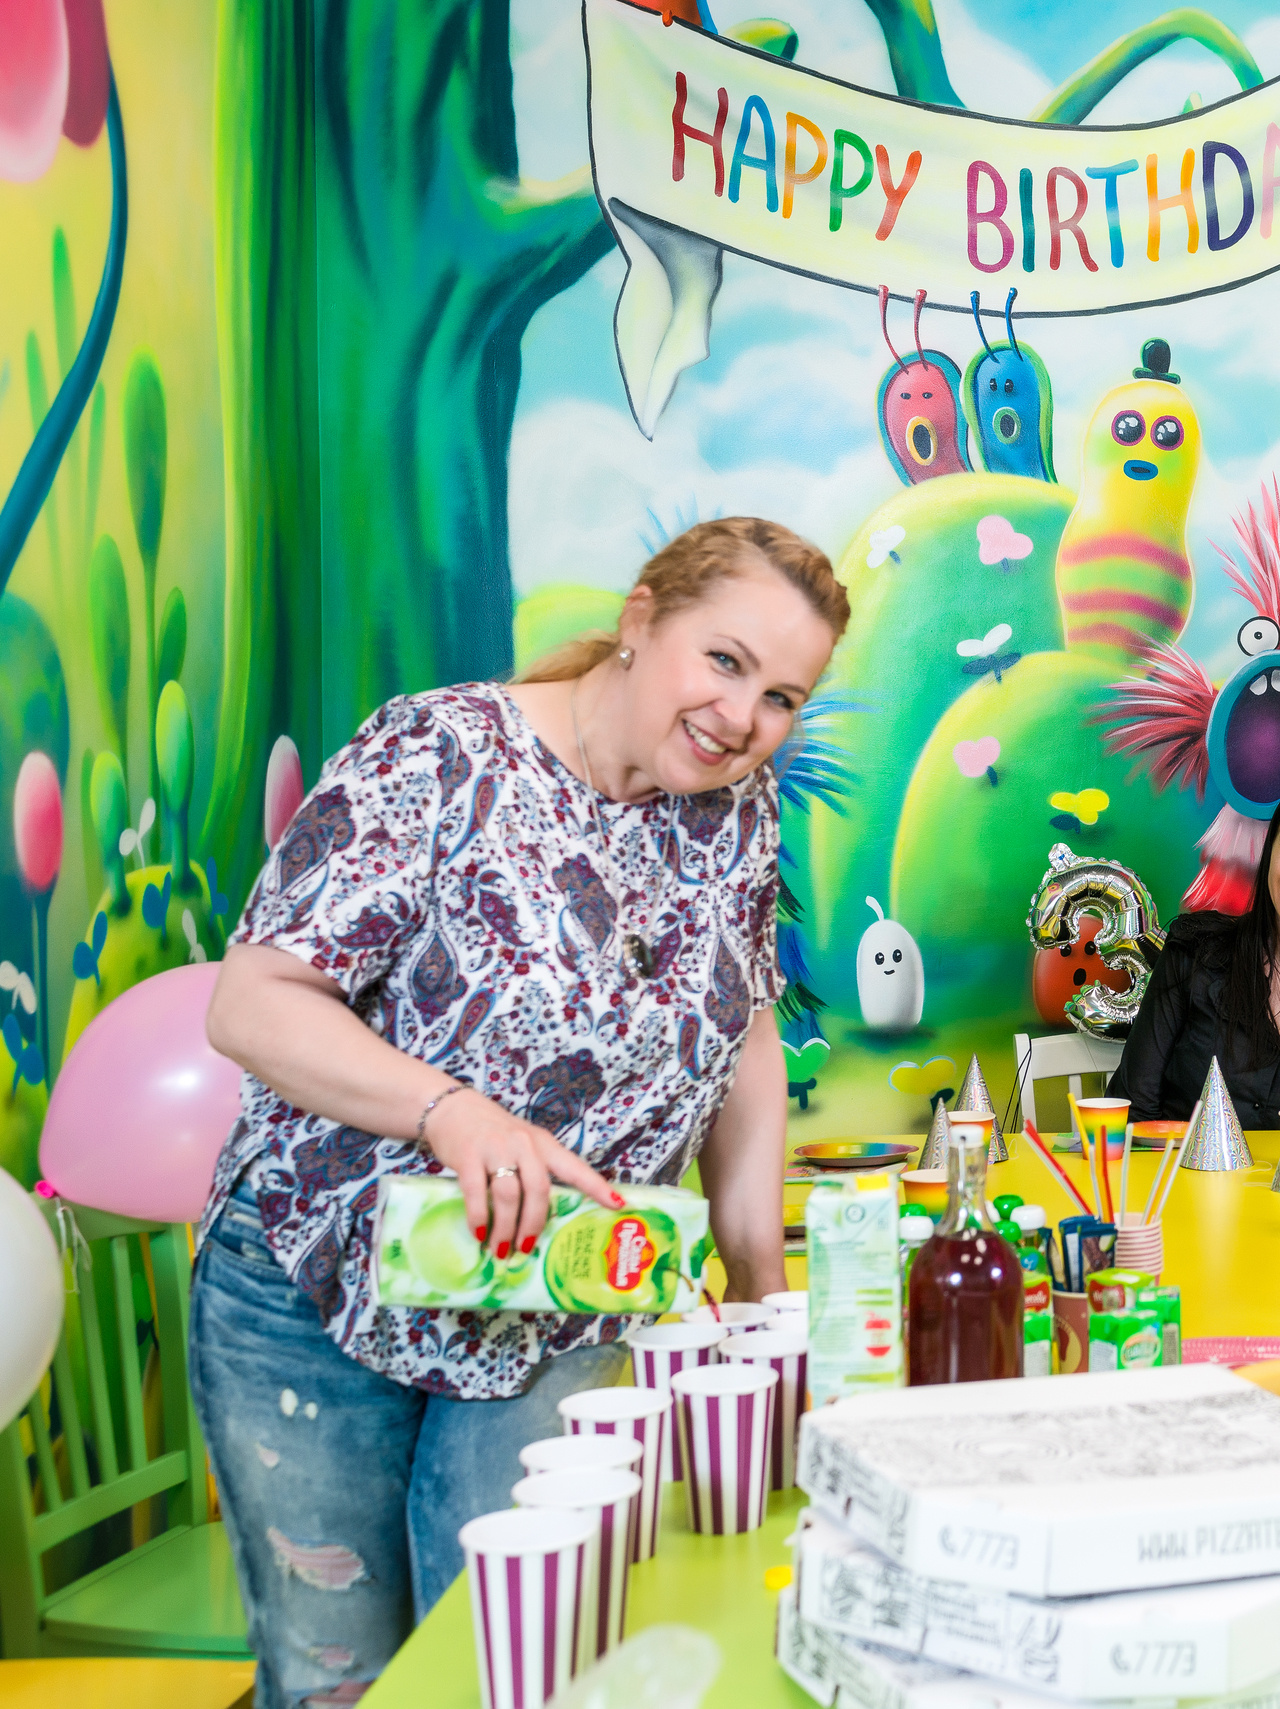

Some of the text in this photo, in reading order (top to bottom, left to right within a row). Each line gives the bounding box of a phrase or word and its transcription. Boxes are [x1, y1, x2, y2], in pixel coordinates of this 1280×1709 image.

[671, 71, 922, 242] HAPPY
[960, 1526, 1019, 1570] 7773
[1134, 1640, 1198, 1677] 7773
